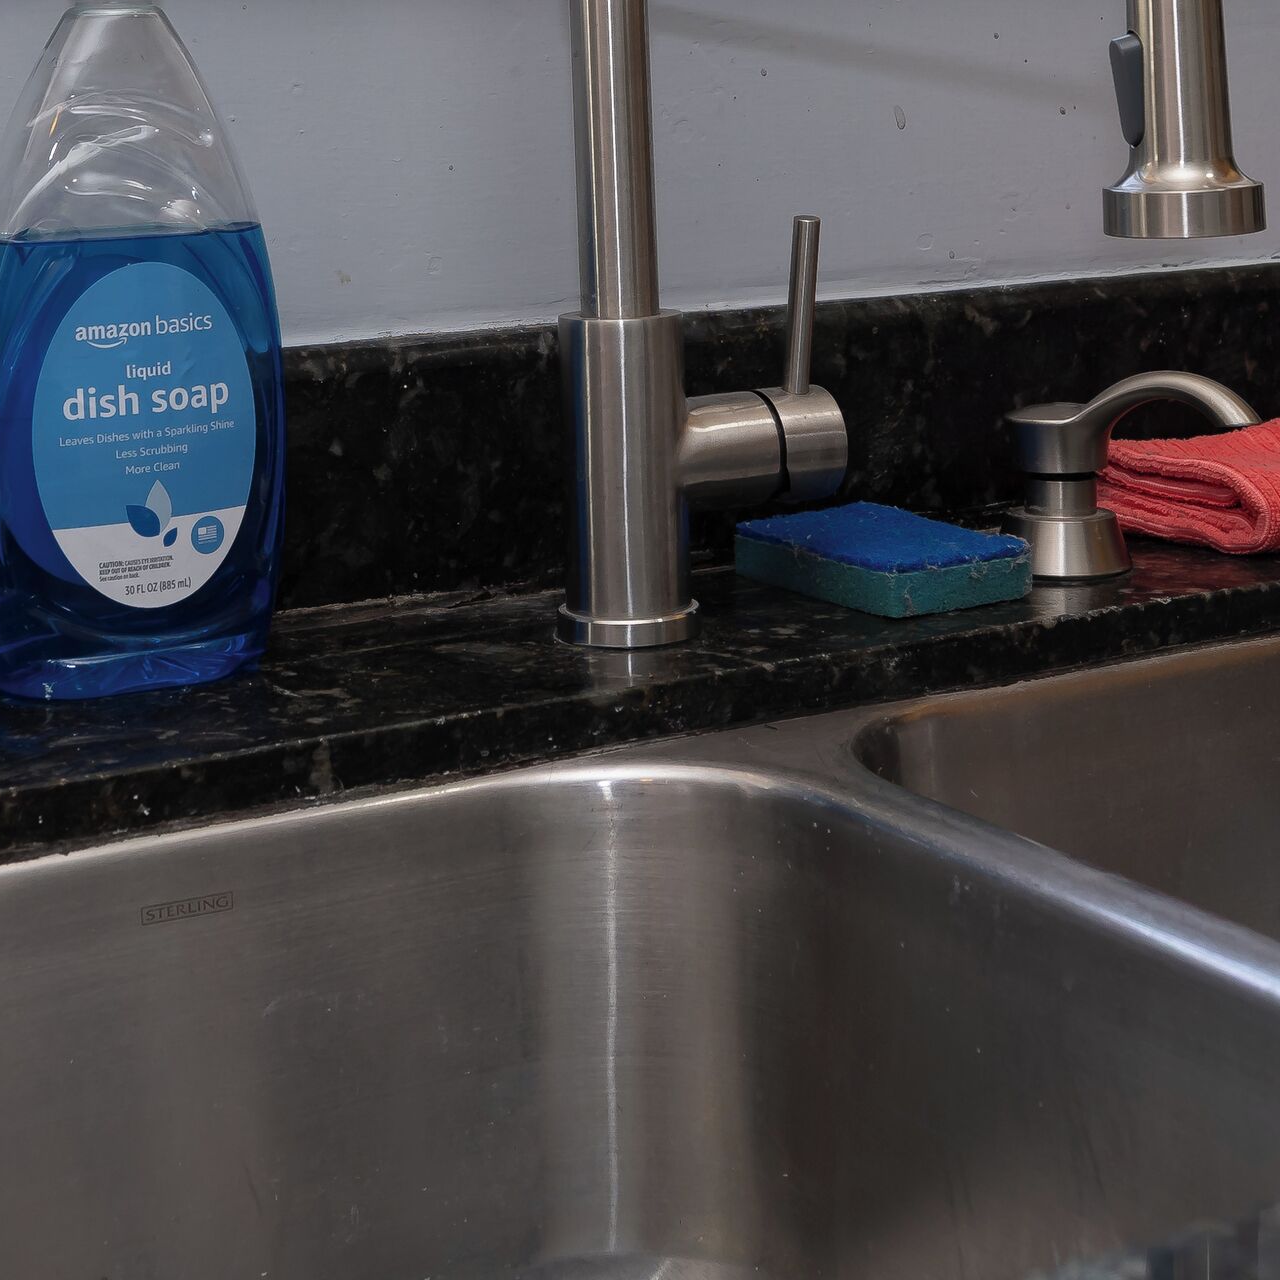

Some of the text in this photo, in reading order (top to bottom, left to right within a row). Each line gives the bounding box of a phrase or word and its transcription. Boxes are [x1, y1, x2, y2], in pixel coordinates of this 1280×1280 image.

[75, 312, 213, 341] amazon basics
[126, 361, 171, 380] liquid
[62, 381, 229, 421] dish soap
[59, 420, 235, 447] Leaves Dishes with a Sparkling Shine
[115, 442, 188, 459] Less Scrubbing
[125, 461, 180, 475] More Clean
[125, 576, 192, 595] 30 FL OZ (885 mL)
[146, 896, 229, 921] STERLING
